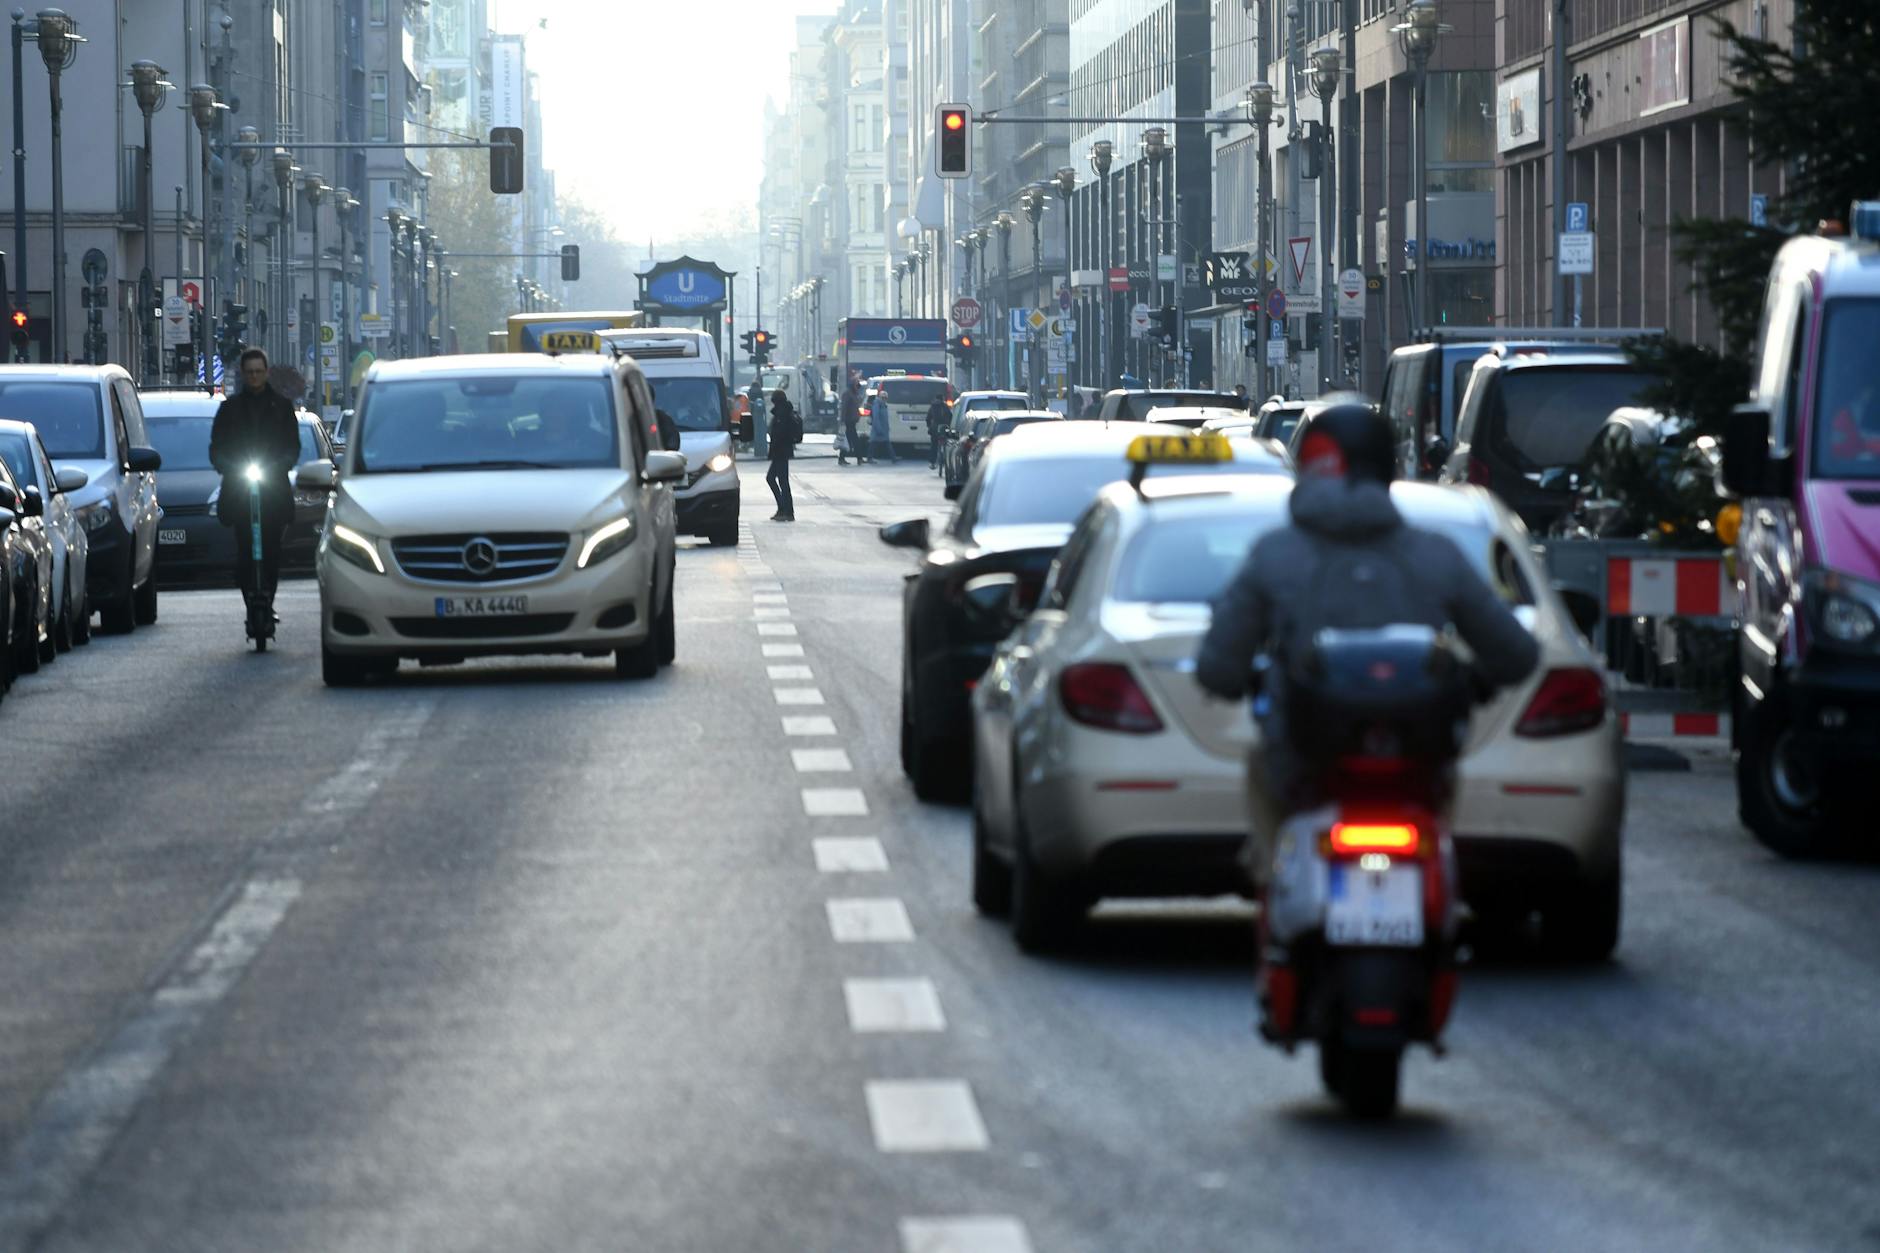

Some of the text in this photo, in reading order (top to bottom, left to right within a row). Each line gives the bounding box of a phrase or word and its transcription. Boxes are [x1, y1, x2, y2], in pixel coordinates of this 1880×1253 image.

[1571, 207, 1583, 229] P
[1128, 270, 1150, 278] ecco
[1220, 257, 1240, 279] WMF
[678, 272, 694, 293] U
[664, 294, 709, 304] Stadtmitte
[953, 307, 979, 320] STOP
[1272, 322, 1280, 336] P
[546, 333, 594, 350] TAXI
[1143, 438, 1217, 460] TAXI
[161, 531, 185, 541] 4020
